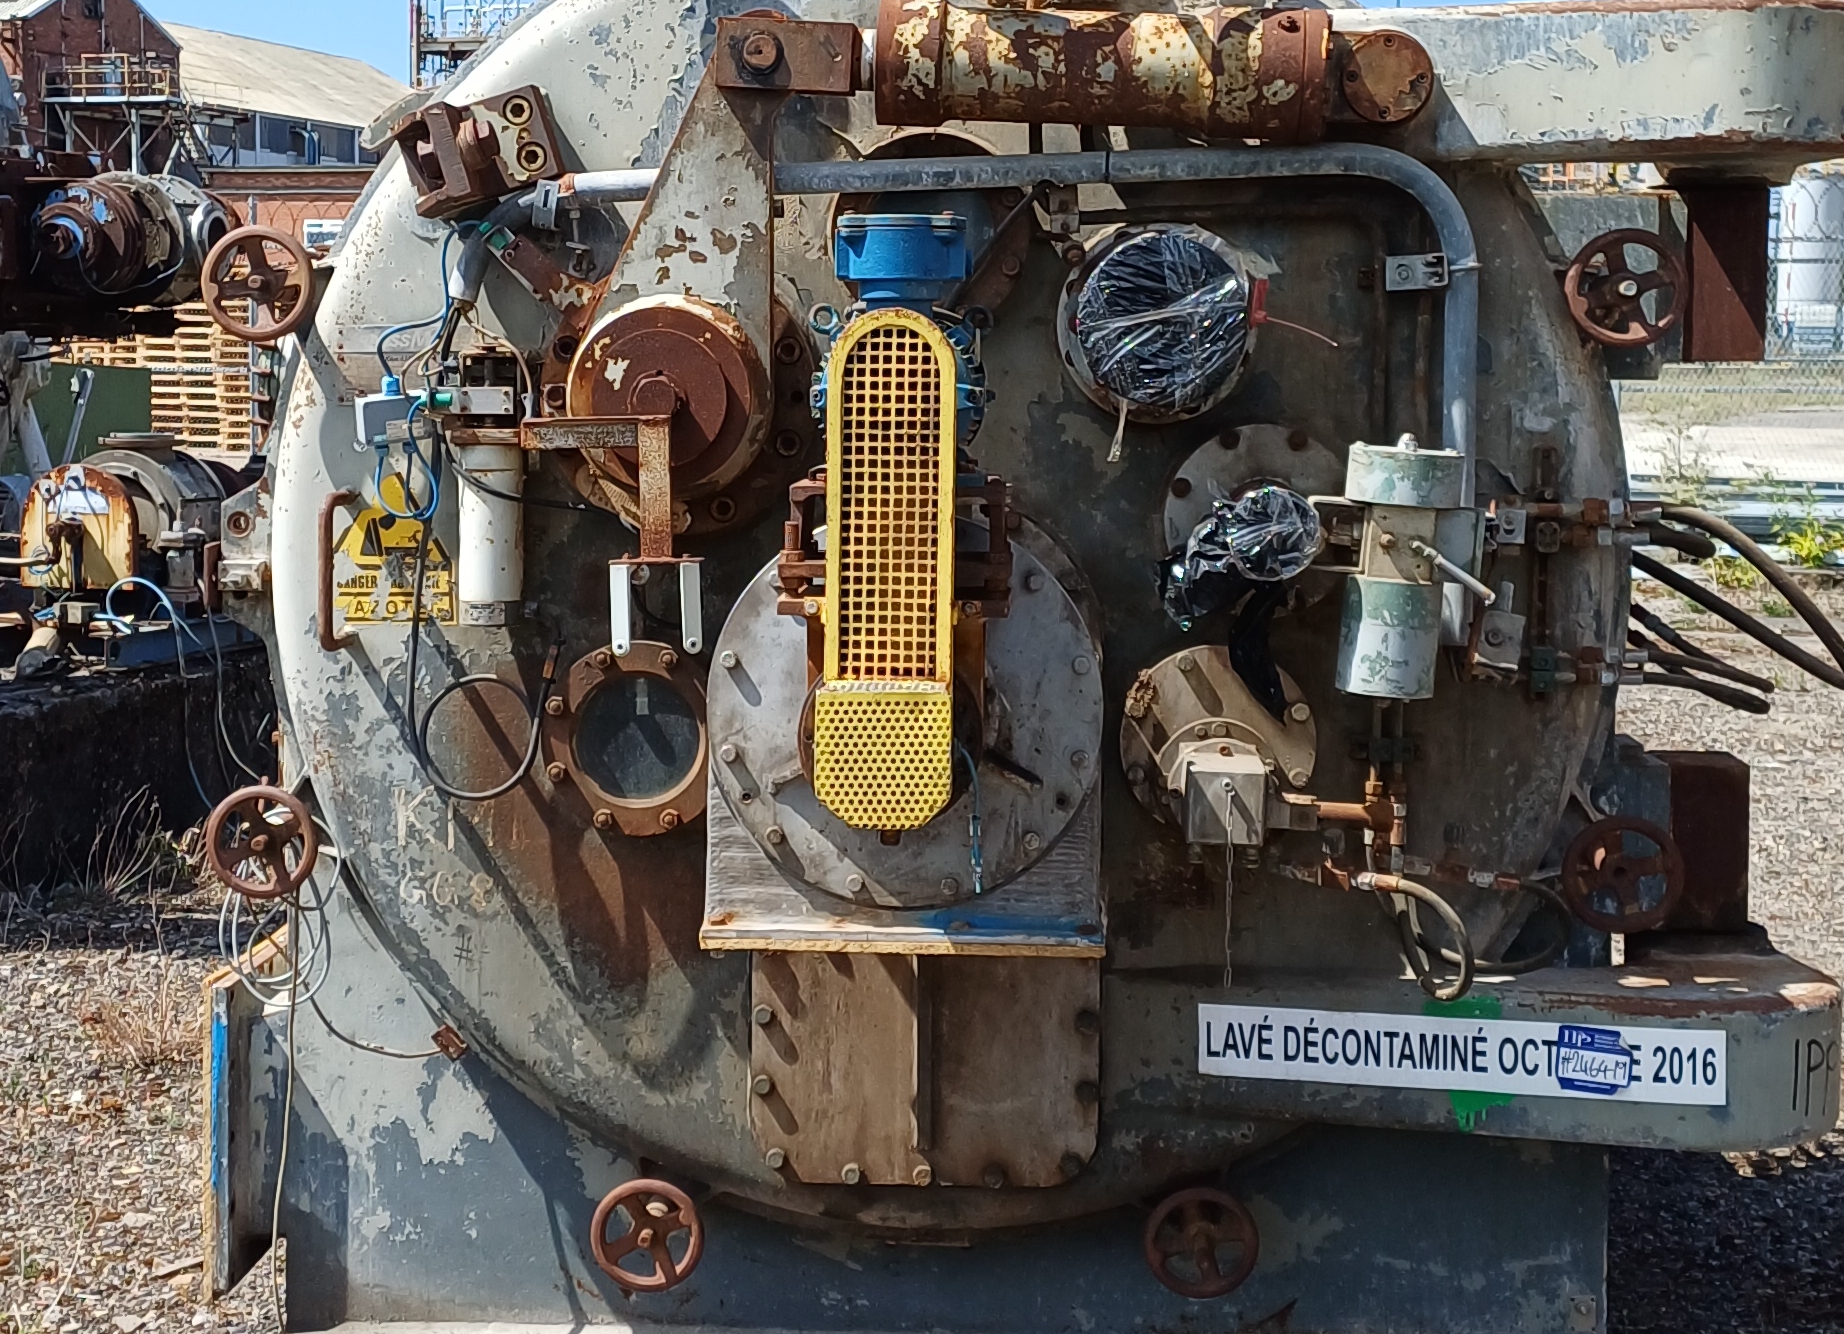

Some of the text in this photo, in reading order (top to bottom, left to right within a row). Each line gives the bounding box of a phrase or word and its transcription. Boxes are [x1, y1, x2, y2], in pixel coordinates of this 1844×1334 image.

[1206, 1015, 1717, 1086] LAVÉ DÉCONTAMINÉ OCTE 2016
